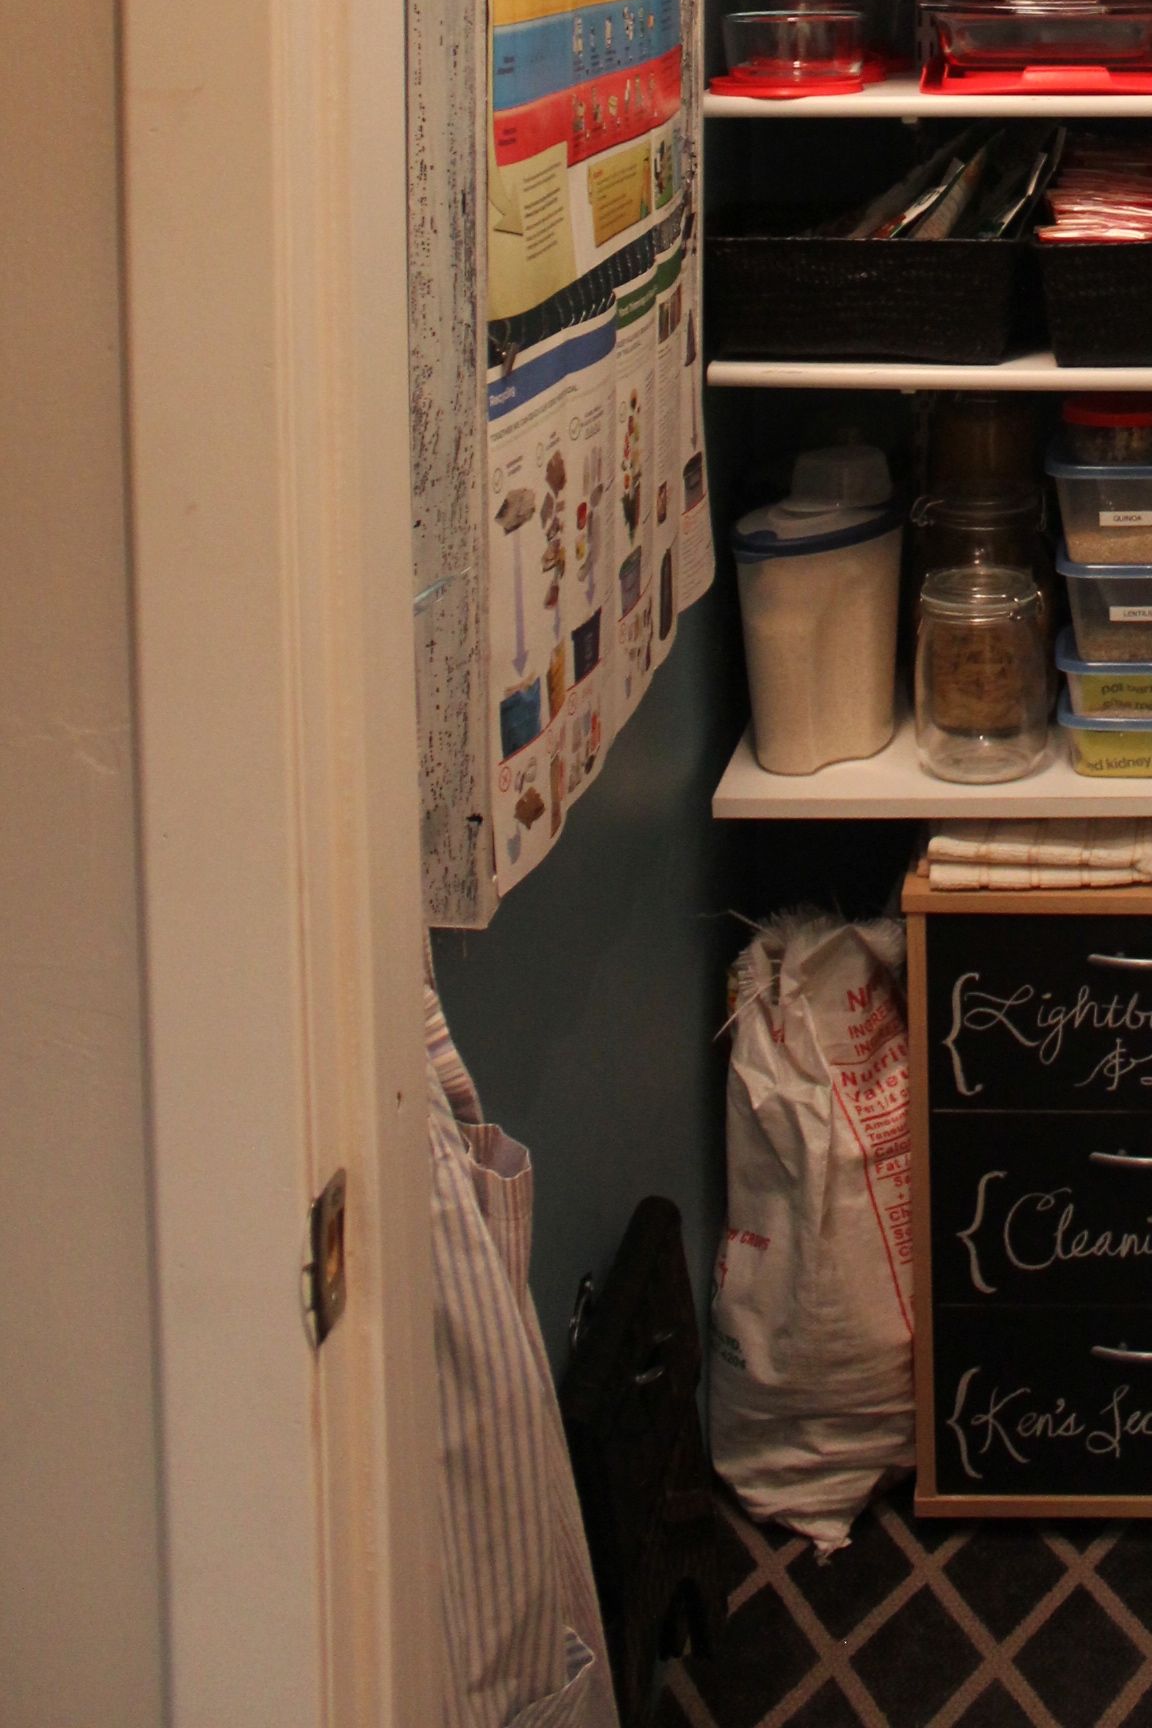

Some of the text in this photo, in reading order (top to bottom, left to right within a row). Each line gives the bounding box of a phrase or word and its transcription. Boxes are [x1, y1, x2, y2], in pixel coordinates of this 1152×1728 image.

[1112, 514, 1142, 522] QUINOA
[1105, 755, 1151, 771] kidney
[970, 1386, 1086, 1464] Ken's
